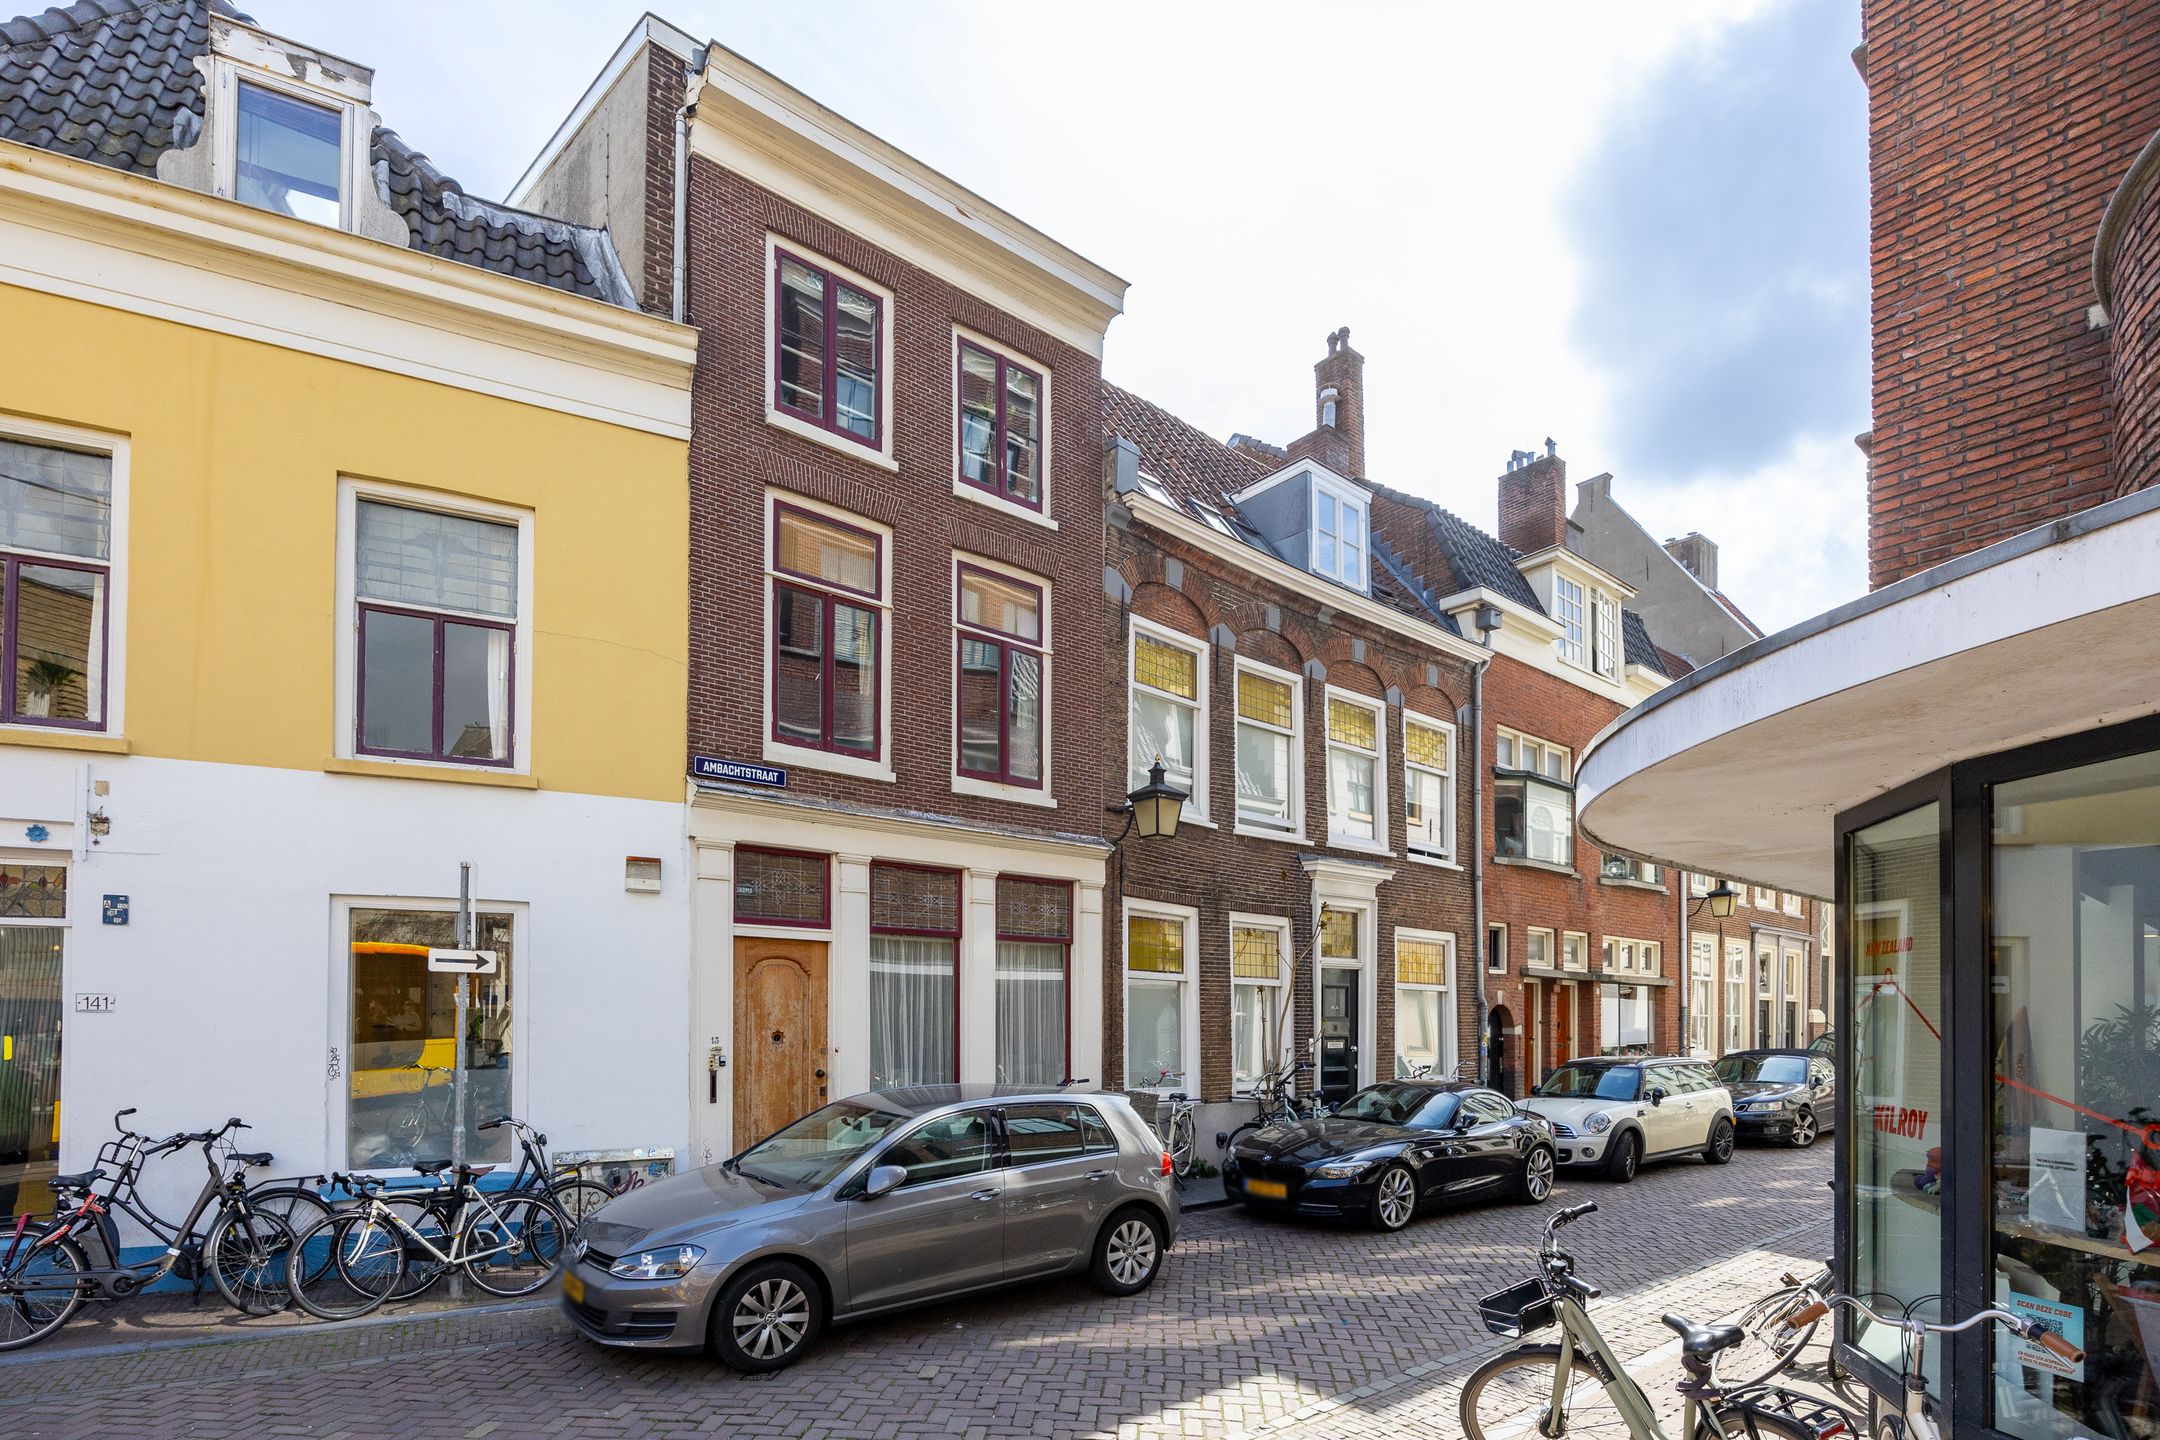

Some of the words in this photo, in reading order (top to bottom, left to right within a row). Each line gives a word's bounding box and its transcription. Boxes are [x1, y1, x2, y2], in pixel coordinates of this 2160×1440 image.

[703, 761, 778, 782] AMBACHTSTRAAT
[711, 1036, 720, 1045] 13
[2016, 1300, 2035, 1311] SCAN
[2035, 1304, 2053, 1313] DEZE
[2054, 1308, 2073, 1318] CODE
[1590, 1354, 1609, 1383] GAZELLE
